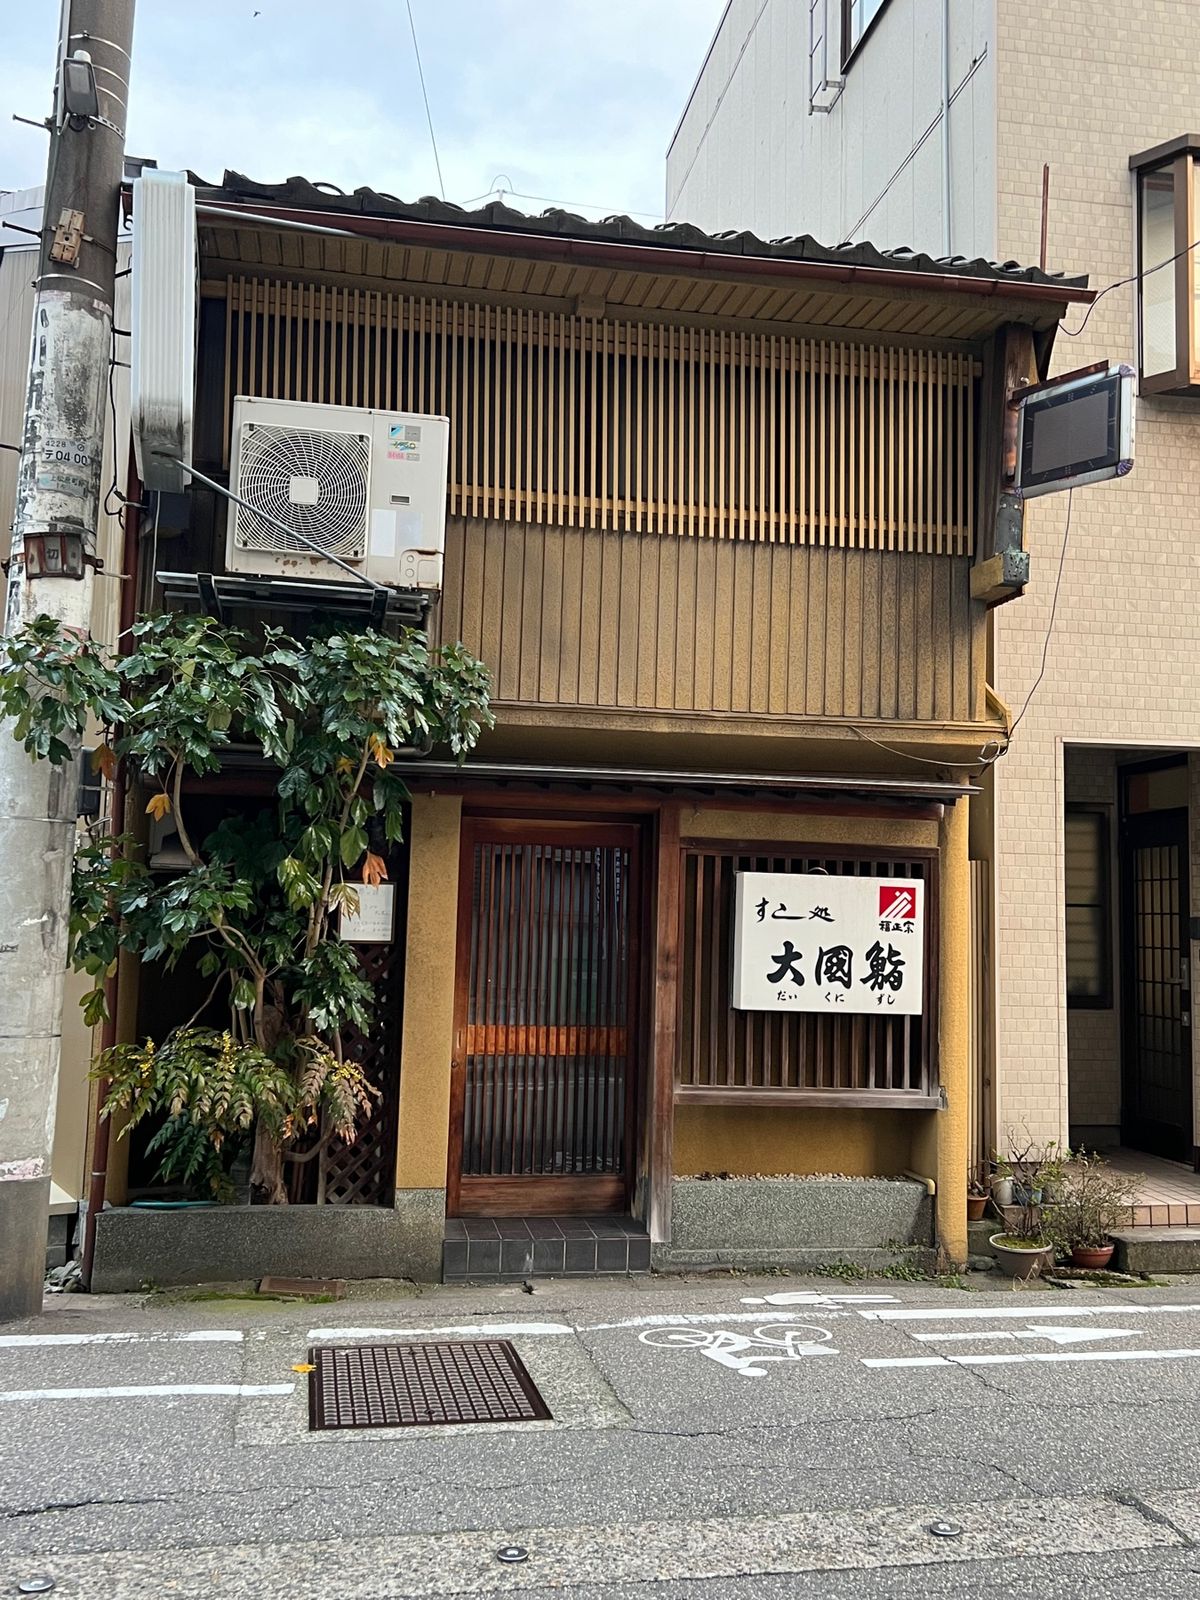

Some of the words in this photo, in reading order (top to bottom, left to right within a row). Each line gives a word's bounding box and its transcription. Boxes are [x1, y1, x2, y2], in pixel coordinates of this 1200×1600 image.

[45, 440, 66, 448] 4228
[878, 920, 915, 934] 福正宗
[776, 990, 798, 1002] だい
[824, 991, 845, 1003] くに
[876, 993, 896, 1006] ずし
